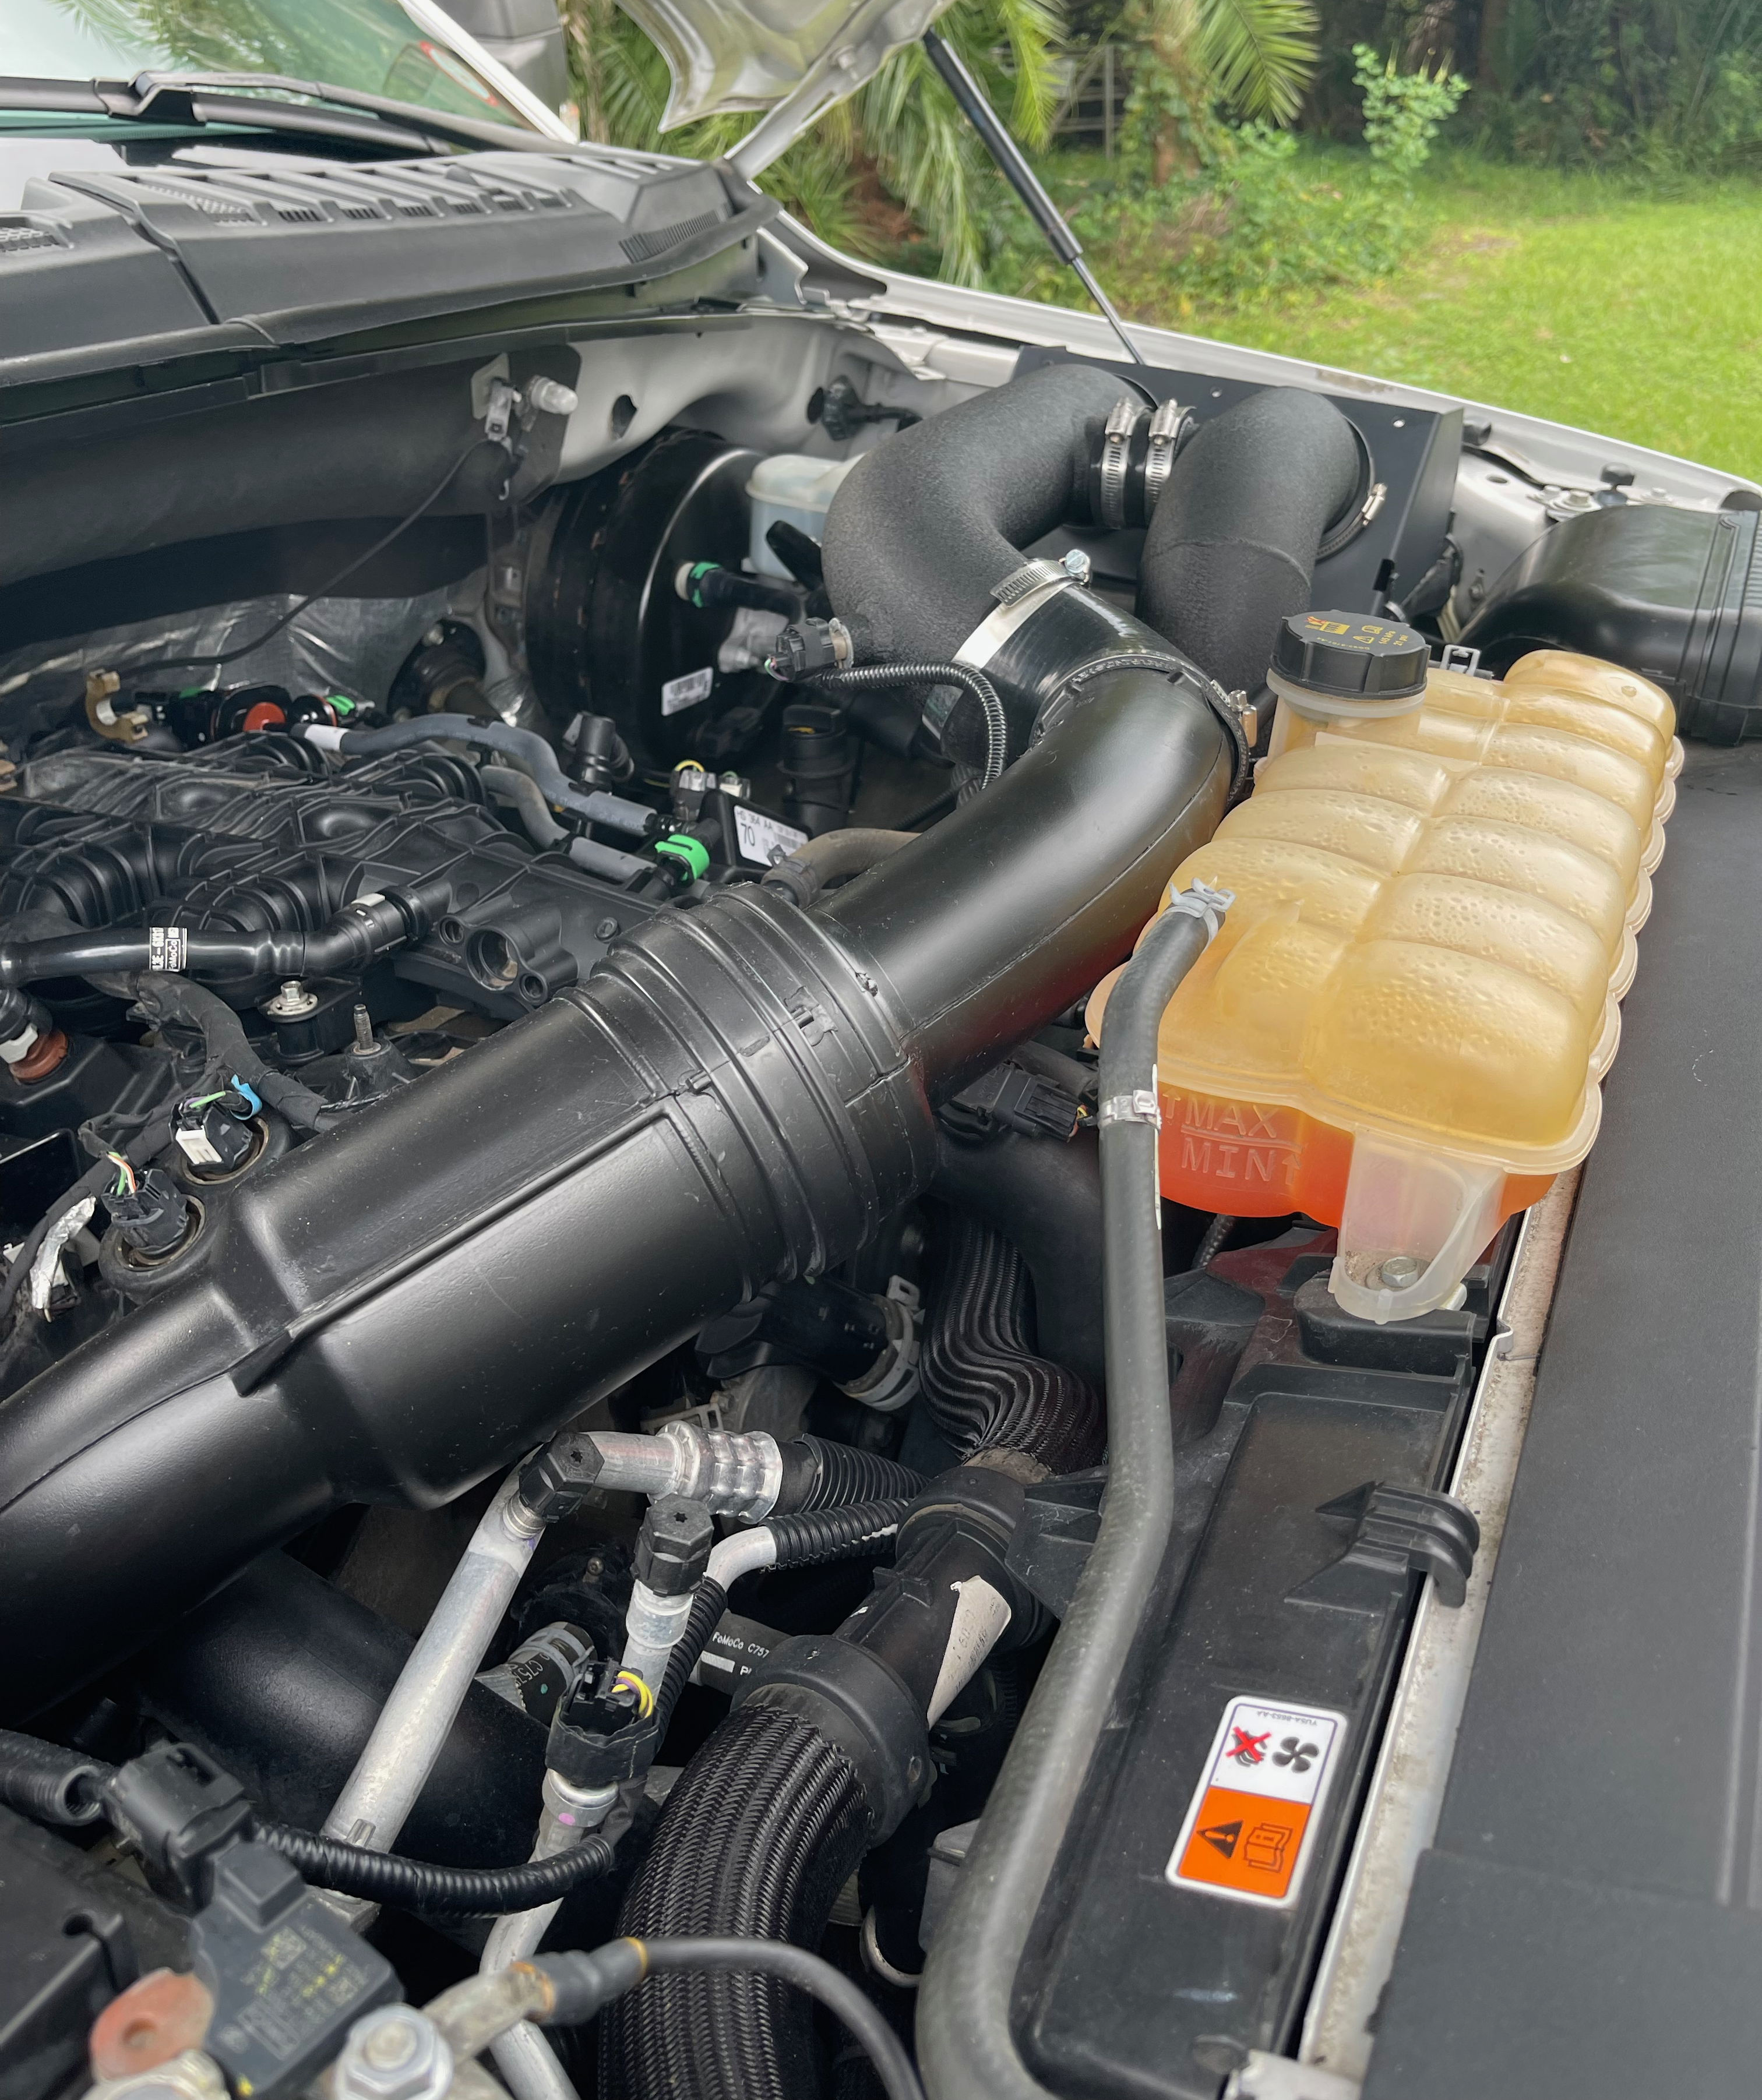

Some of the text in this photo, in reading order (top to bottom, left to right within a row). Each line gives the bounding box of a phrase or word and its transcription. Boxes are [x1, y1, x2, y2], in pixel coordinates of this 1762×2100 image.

[1185, 1096, 1278, 1138] MAX
[1182, 1138, 1277, 1182] MIN
[712, 1631, 745, 1650] FoMoCo
